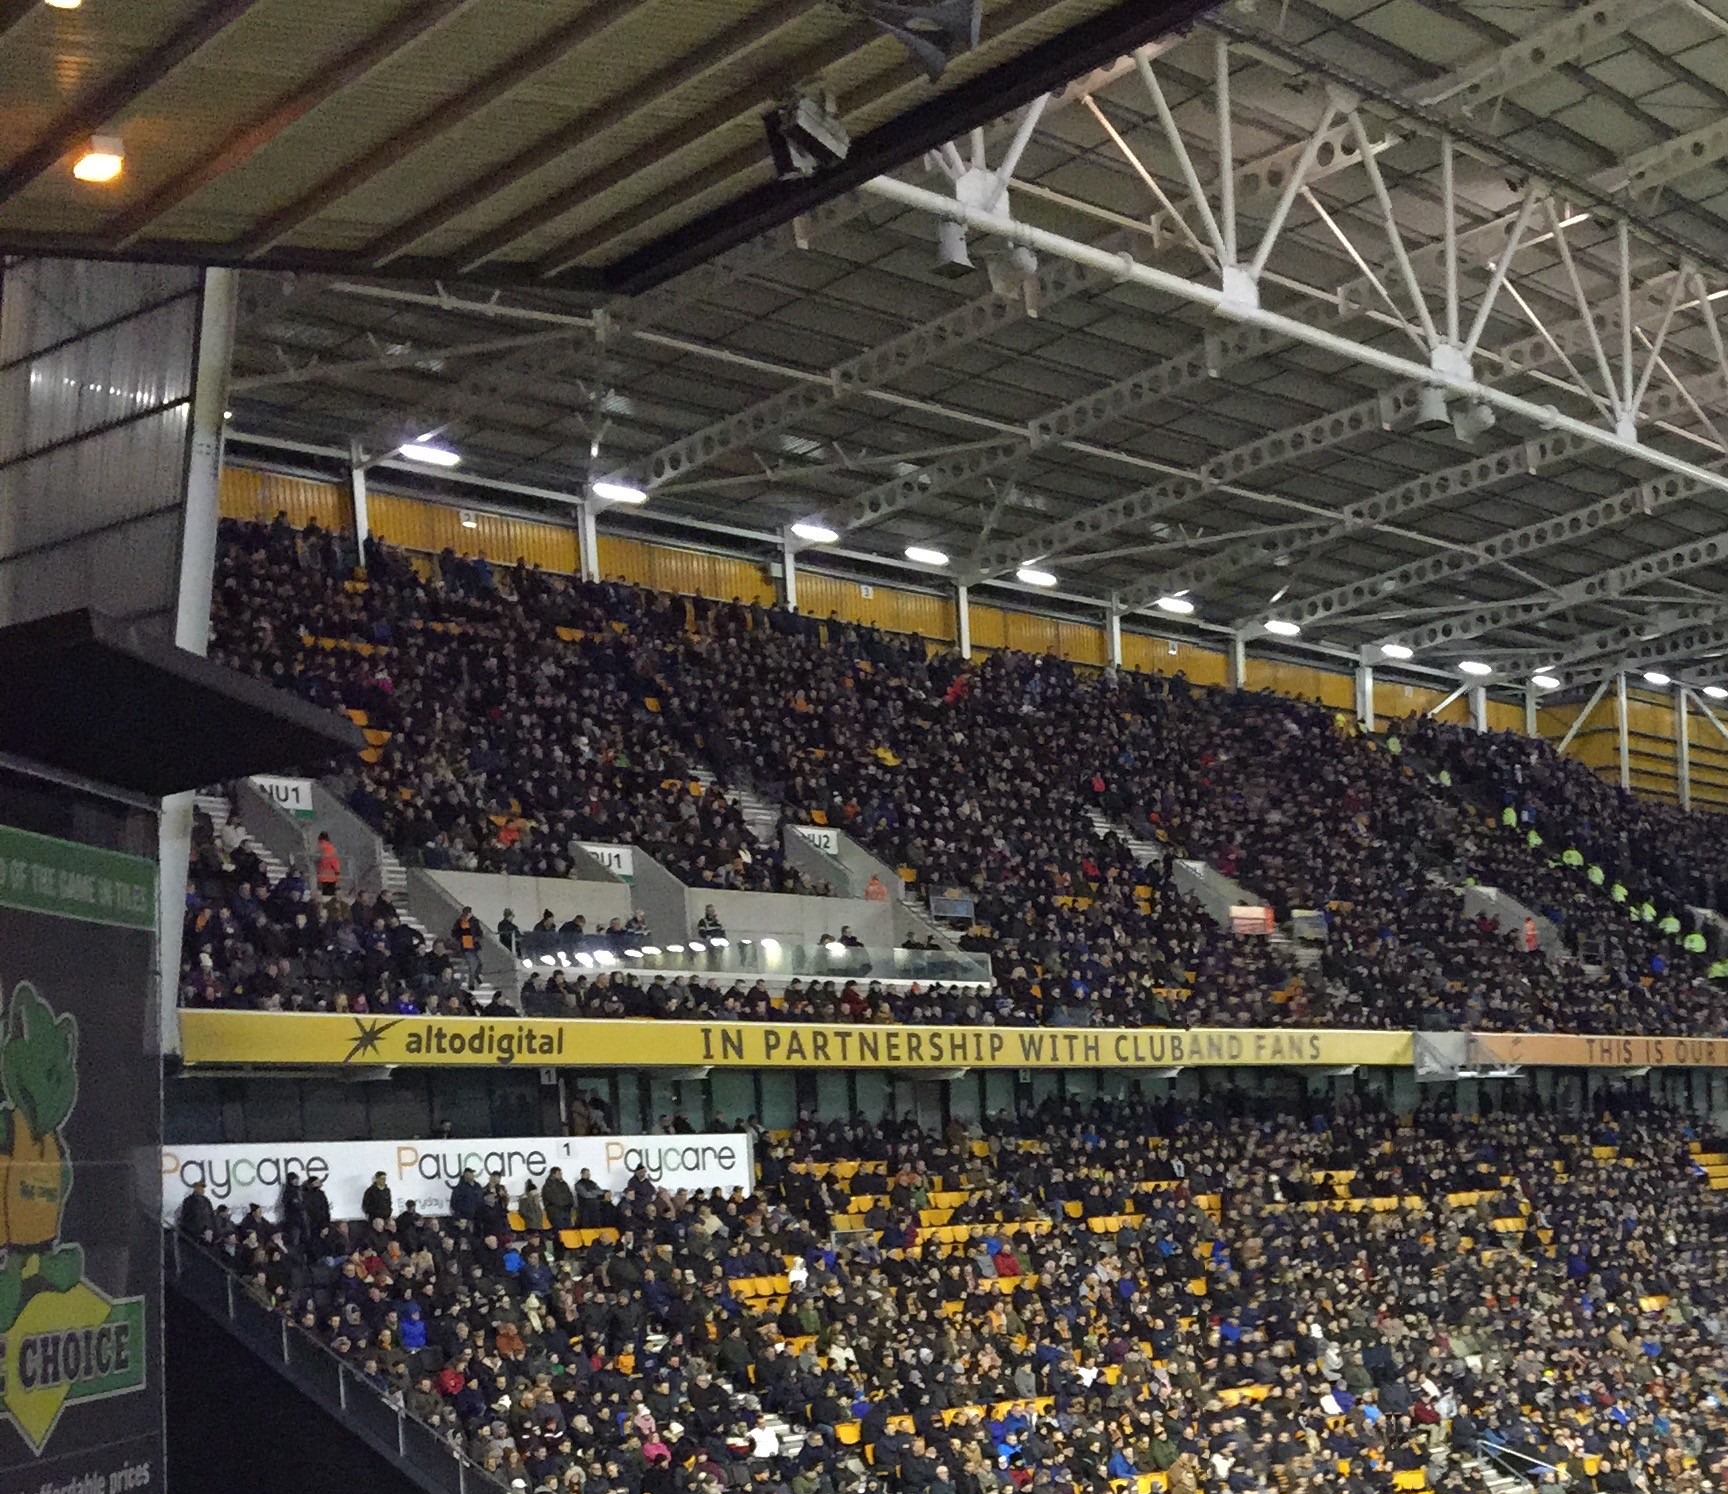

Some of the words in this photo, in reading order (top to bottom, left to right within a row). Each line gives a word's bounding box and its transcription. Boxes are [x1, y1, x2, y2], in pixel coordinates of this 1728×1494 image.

[405, 1024, 565, 1064] altodigital
[702, 1028, 744, 1061] IN
[764, 1028, 1004, 1064] PARTNERSHIP
[1021, 1034, 1101, 1064] WITH
[1253, 1034, 1321, 1062] FANS
[1586, 1039, 1632, 1064] THIS
[1645, 1040, 1665, 1064] IS
[1675, 1041, 1716, 1065] OUR
[161, 1152, 330, 1200] Paycare
[397, 1145, 548, 1189] Paycare
[605, 1141, 736, 1183] Paycare
[19, 1322, 129, 1390] CHOICE
